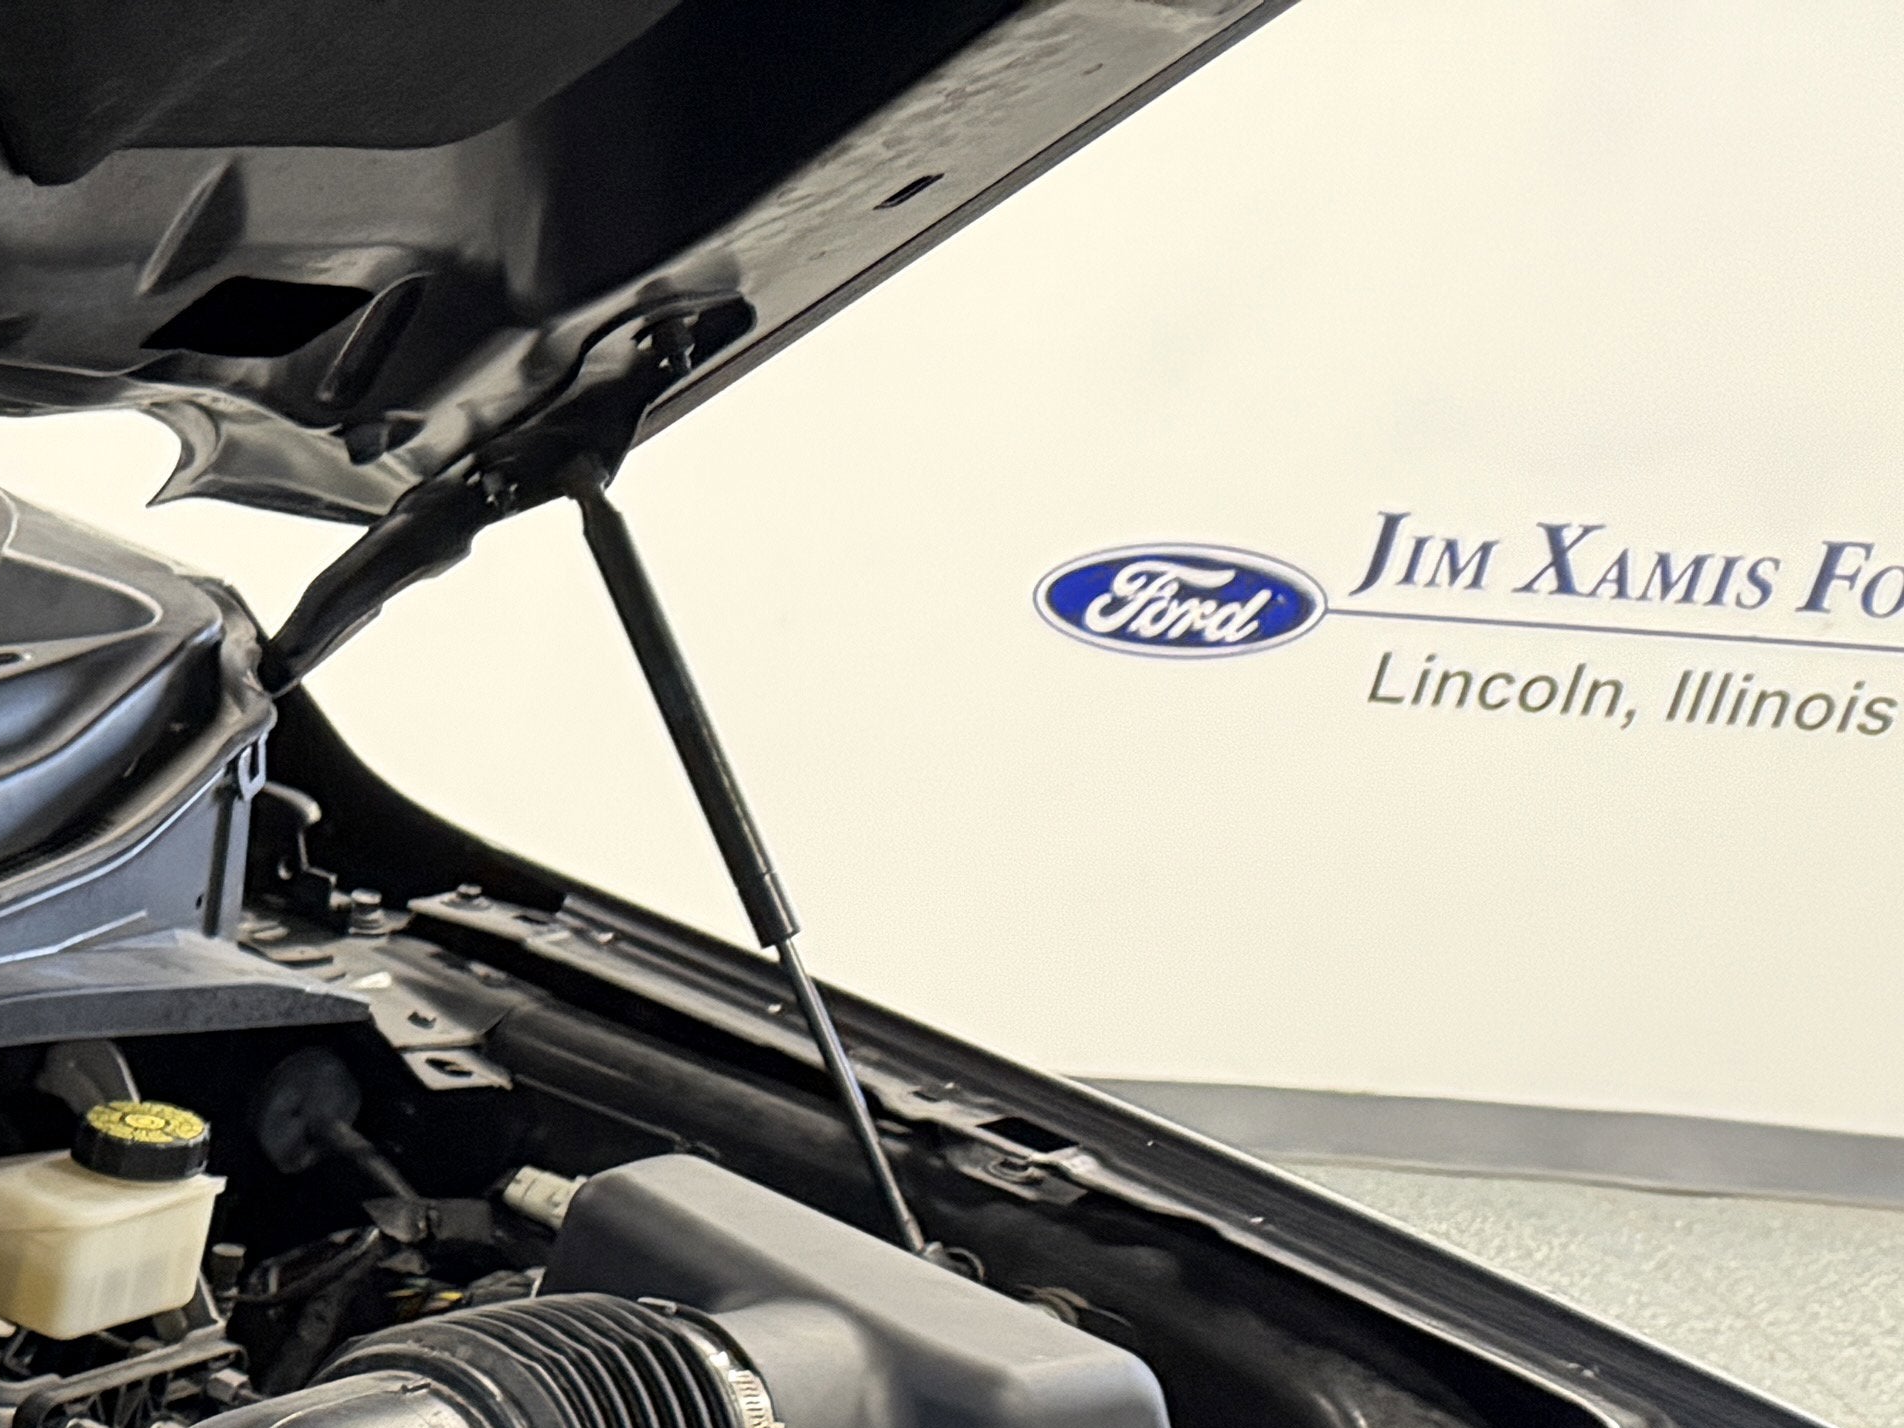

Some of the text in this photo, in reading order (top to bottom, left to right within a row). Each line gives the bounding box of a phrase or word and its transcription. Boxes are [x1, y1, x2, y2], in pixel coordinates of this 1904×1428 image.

[1082, 558, 1271, 647] Ford
[1367, 651, 1898, 736] Lincoln, Illinois
